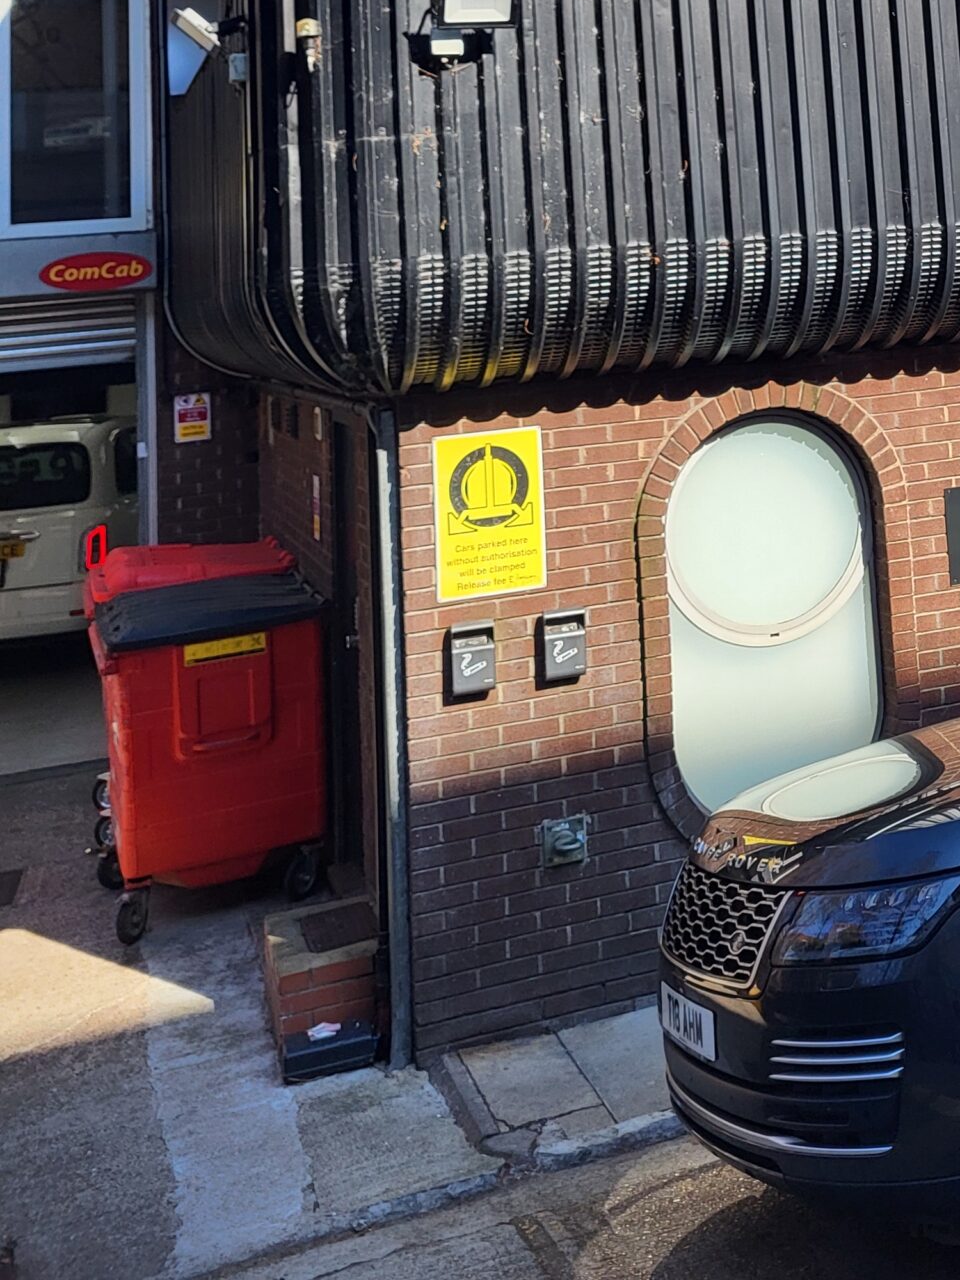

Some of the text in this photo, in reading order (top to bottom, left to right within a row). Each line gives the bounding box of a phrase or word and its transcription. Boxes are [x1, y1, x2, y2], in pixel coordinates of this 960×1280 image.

[49, 261, 144, 282] ComCab
[455, 537, 528, 553] Cars parked here
[446, 548, 538, 566] without authorisation
[459, 562, 526, 577] will be clamped
[457, 580, 491, 591] Release
[727, 853, 783, 874] ROVER
